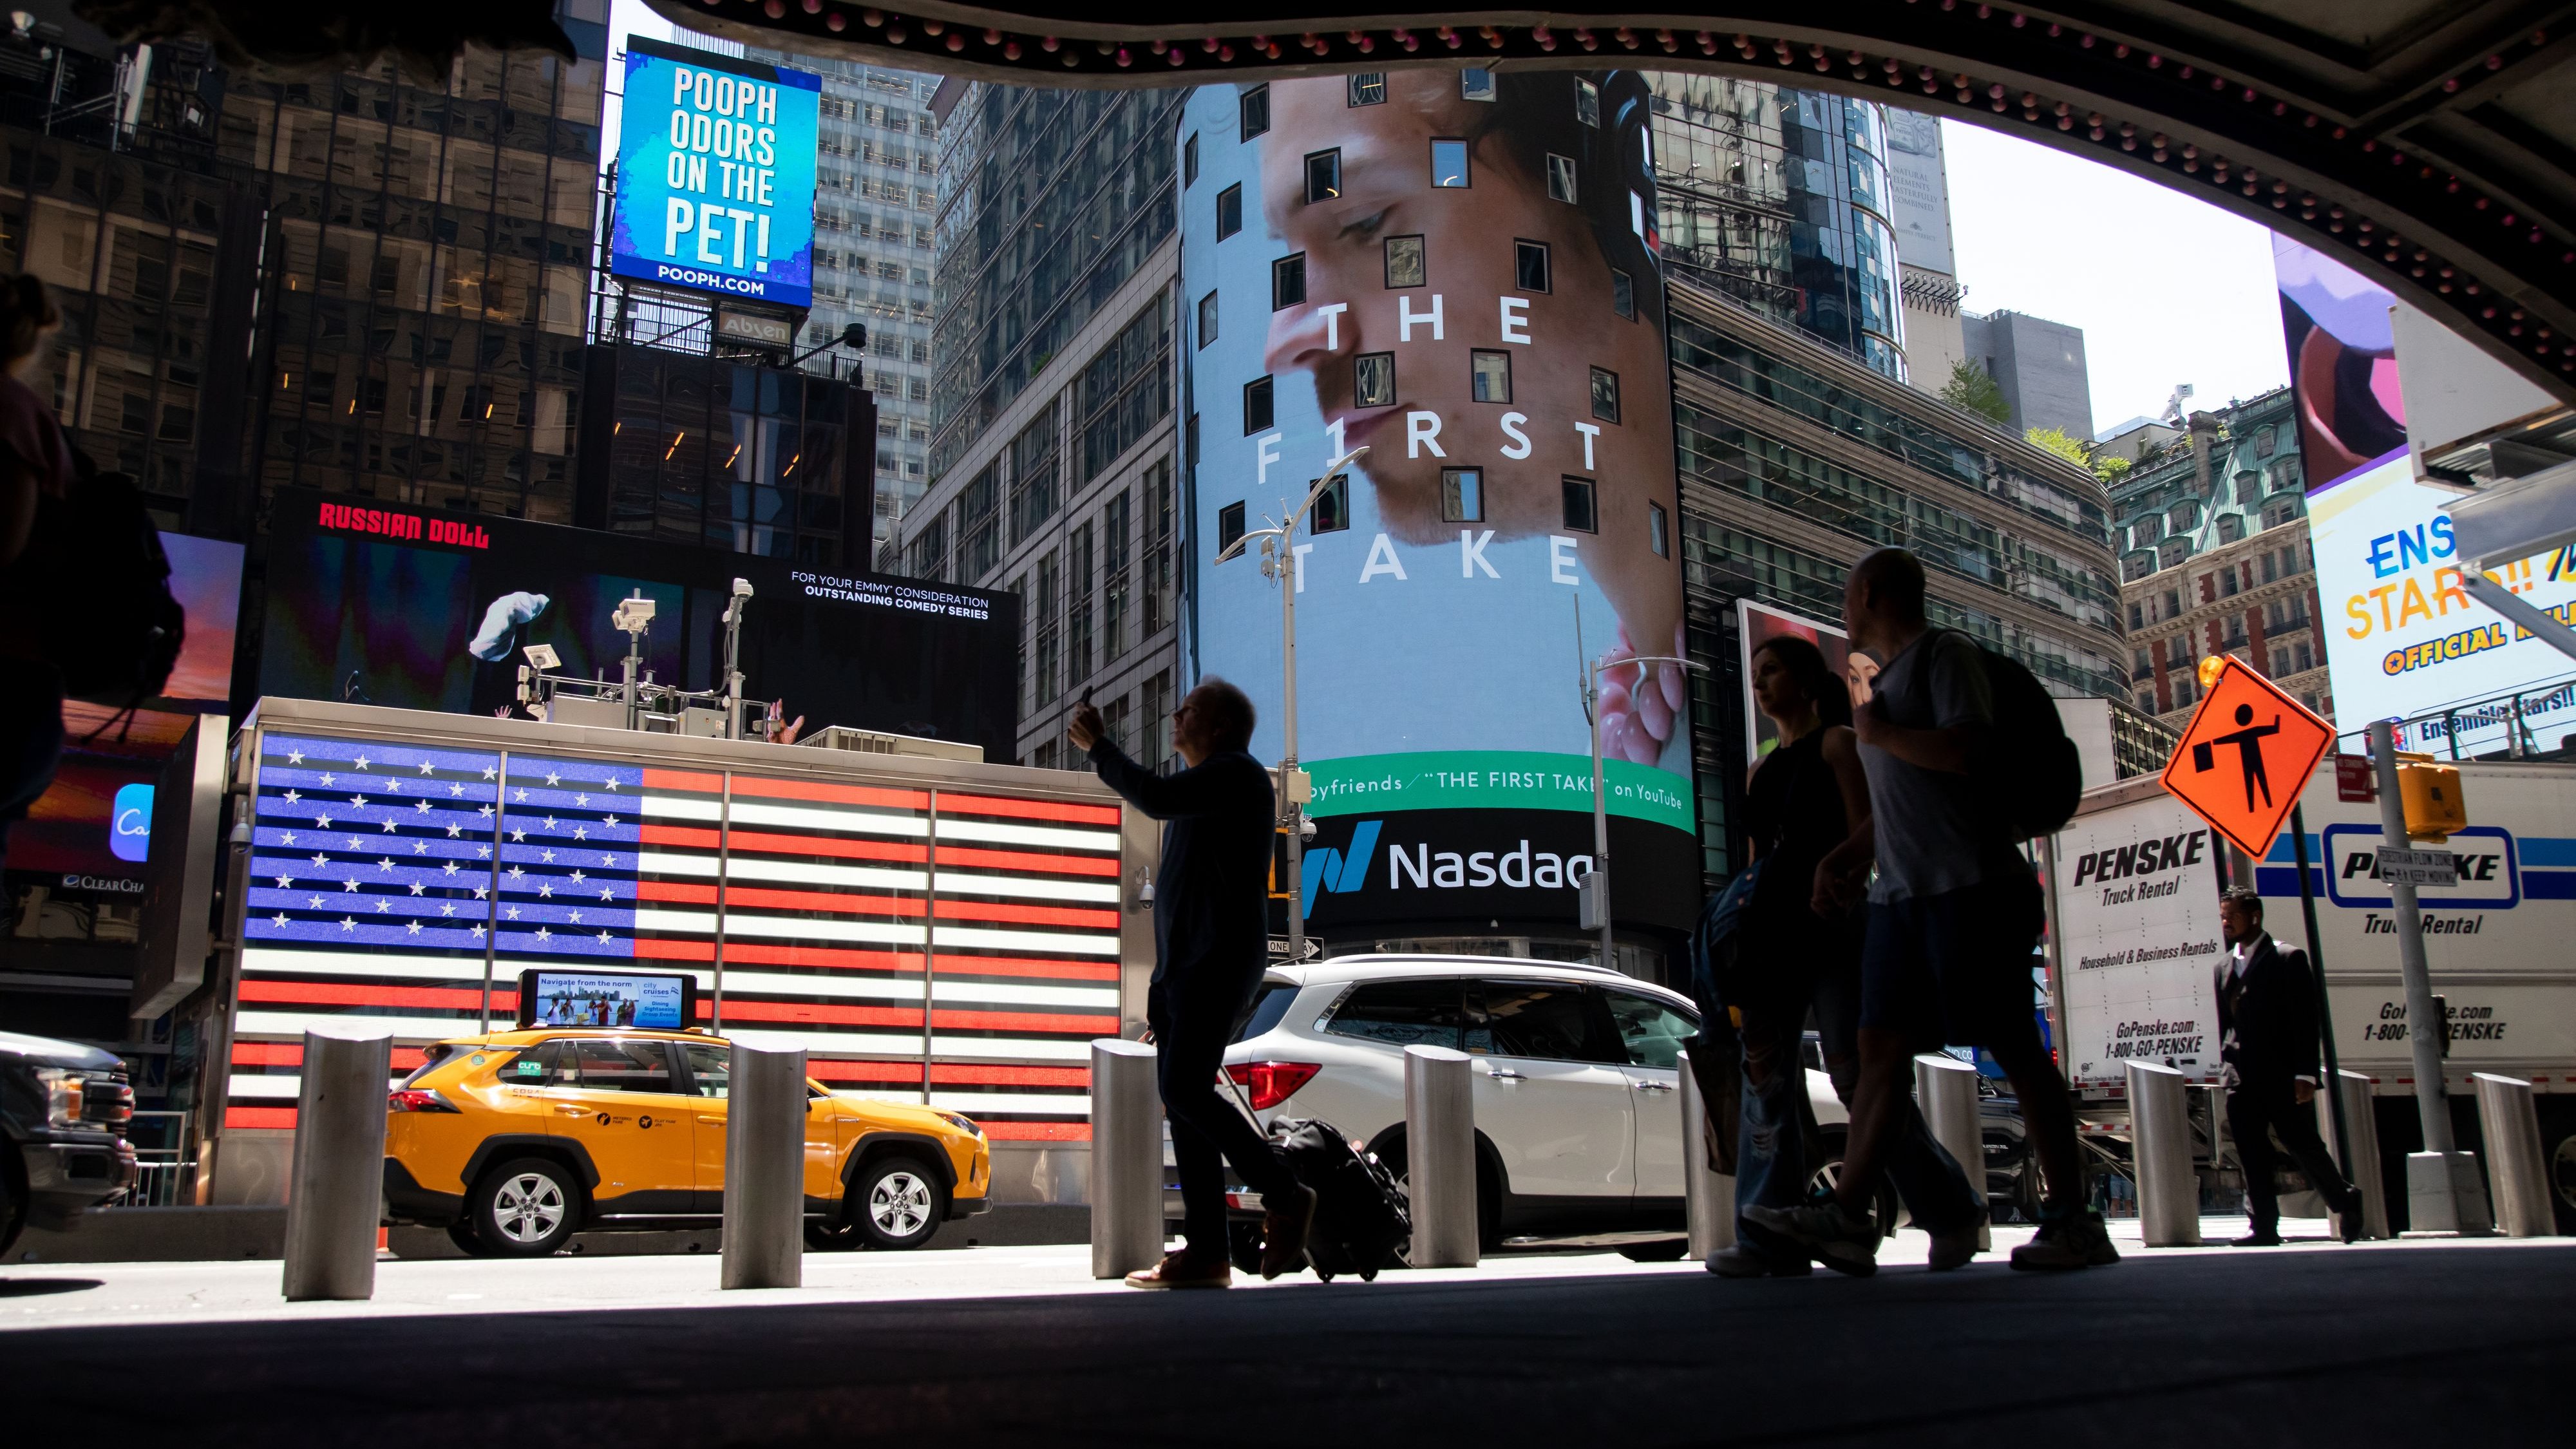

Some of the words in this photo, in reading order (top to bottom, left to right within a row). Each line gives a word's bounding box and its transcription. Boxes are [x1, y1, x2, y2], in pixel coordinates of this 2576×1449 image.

[673, 67, 777, 125] POOPH
[670, 109, 776, 166] ODORS
[667, 151, 708, 194] ON
[719, 161, 775, 207] THE
[1893, 166, 1928, 181] NATURAL
[1893, 176, 1930, 192] ELEMENTS
[665, 197, 771, 273] PET!
[658, 265, 764, 296] POOPH.COM
[723, 311, 786, 339] Absen
[1318, 294, 1531, 350] THE
[319, 502, 422, 540] RUSSIAN
[428, 518, 489, 549] DOLL
[1292, 529, 1579, 594] TAKE
[791, 571, 816, 583] FOR
[819, 574, 853, 589] YOUR
[895, 586, 989, 609] CONSIDERATION
[805, 585, 893, 607] OUTSTANDING
[895, 598, 946, 614] COMEDY
[948, 605, 989, 620] SERIES
[2345, 558, 2533, 640] STAR!!
[2513, 686, 2575, 716] tars!!
[1309, 774, 1402, 801] oyfriends
[1489, 771, 1546, 788] FIRST
[1615, 784, 1633, 798] on
[1636, 783, 1682, 810] YouTube
[2074, 829, 2208, 887] PENSKE
[2342, 853, 2501, 881] PKE
[2102, 884, 2134, 907] Truck
[2137, 875, 2181, 901] Rental
[2365, 913, 2398, 934] Tru
[2421, 914, 2483, 934] Rental
[1270, 942, 1288, 952] ONE
[1303, 945, 1314, 953] AY
[2079, 949, 2125, 971] Household
[2126, 949, 2134, 964] &
[2136, 944, 2179, 963] Business
[2180, 938, 2217, 957] Rentals
[540, 978, 575, 987] Navigate
[643, 981, 657, 990] city
[2380, 1001, 2494, 1019] Goe.com
[2116, 1019, 2195, 1039] GoPenske.com
[2105, 1036, 2204, 1059] 1-800-GO-PENSKE
